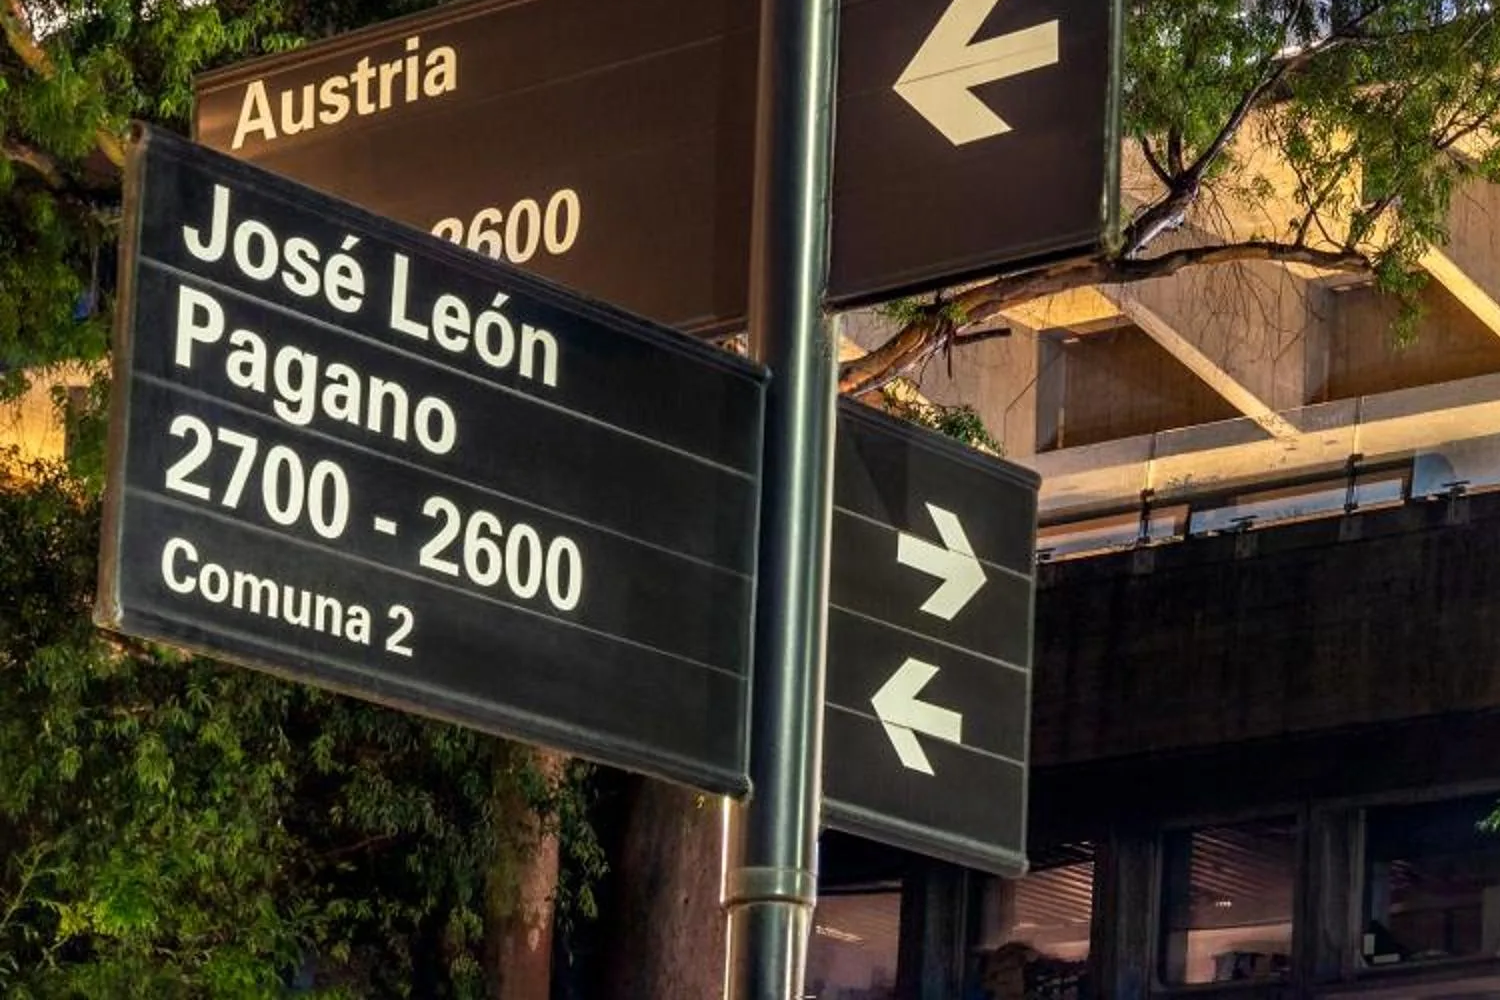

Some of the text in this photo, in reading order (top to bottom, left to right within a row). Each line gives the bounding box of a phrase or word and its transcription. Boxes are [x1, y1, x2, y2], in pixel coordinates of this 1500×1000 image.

[231, 35, 457, 149] Austria
[174, 284, 457, 455] Pagano
[182, 183, 558, 387] José León
[161, 536, 415, 657] Comuna 2
[165, 414, 583, 612] 2700 - 2600
